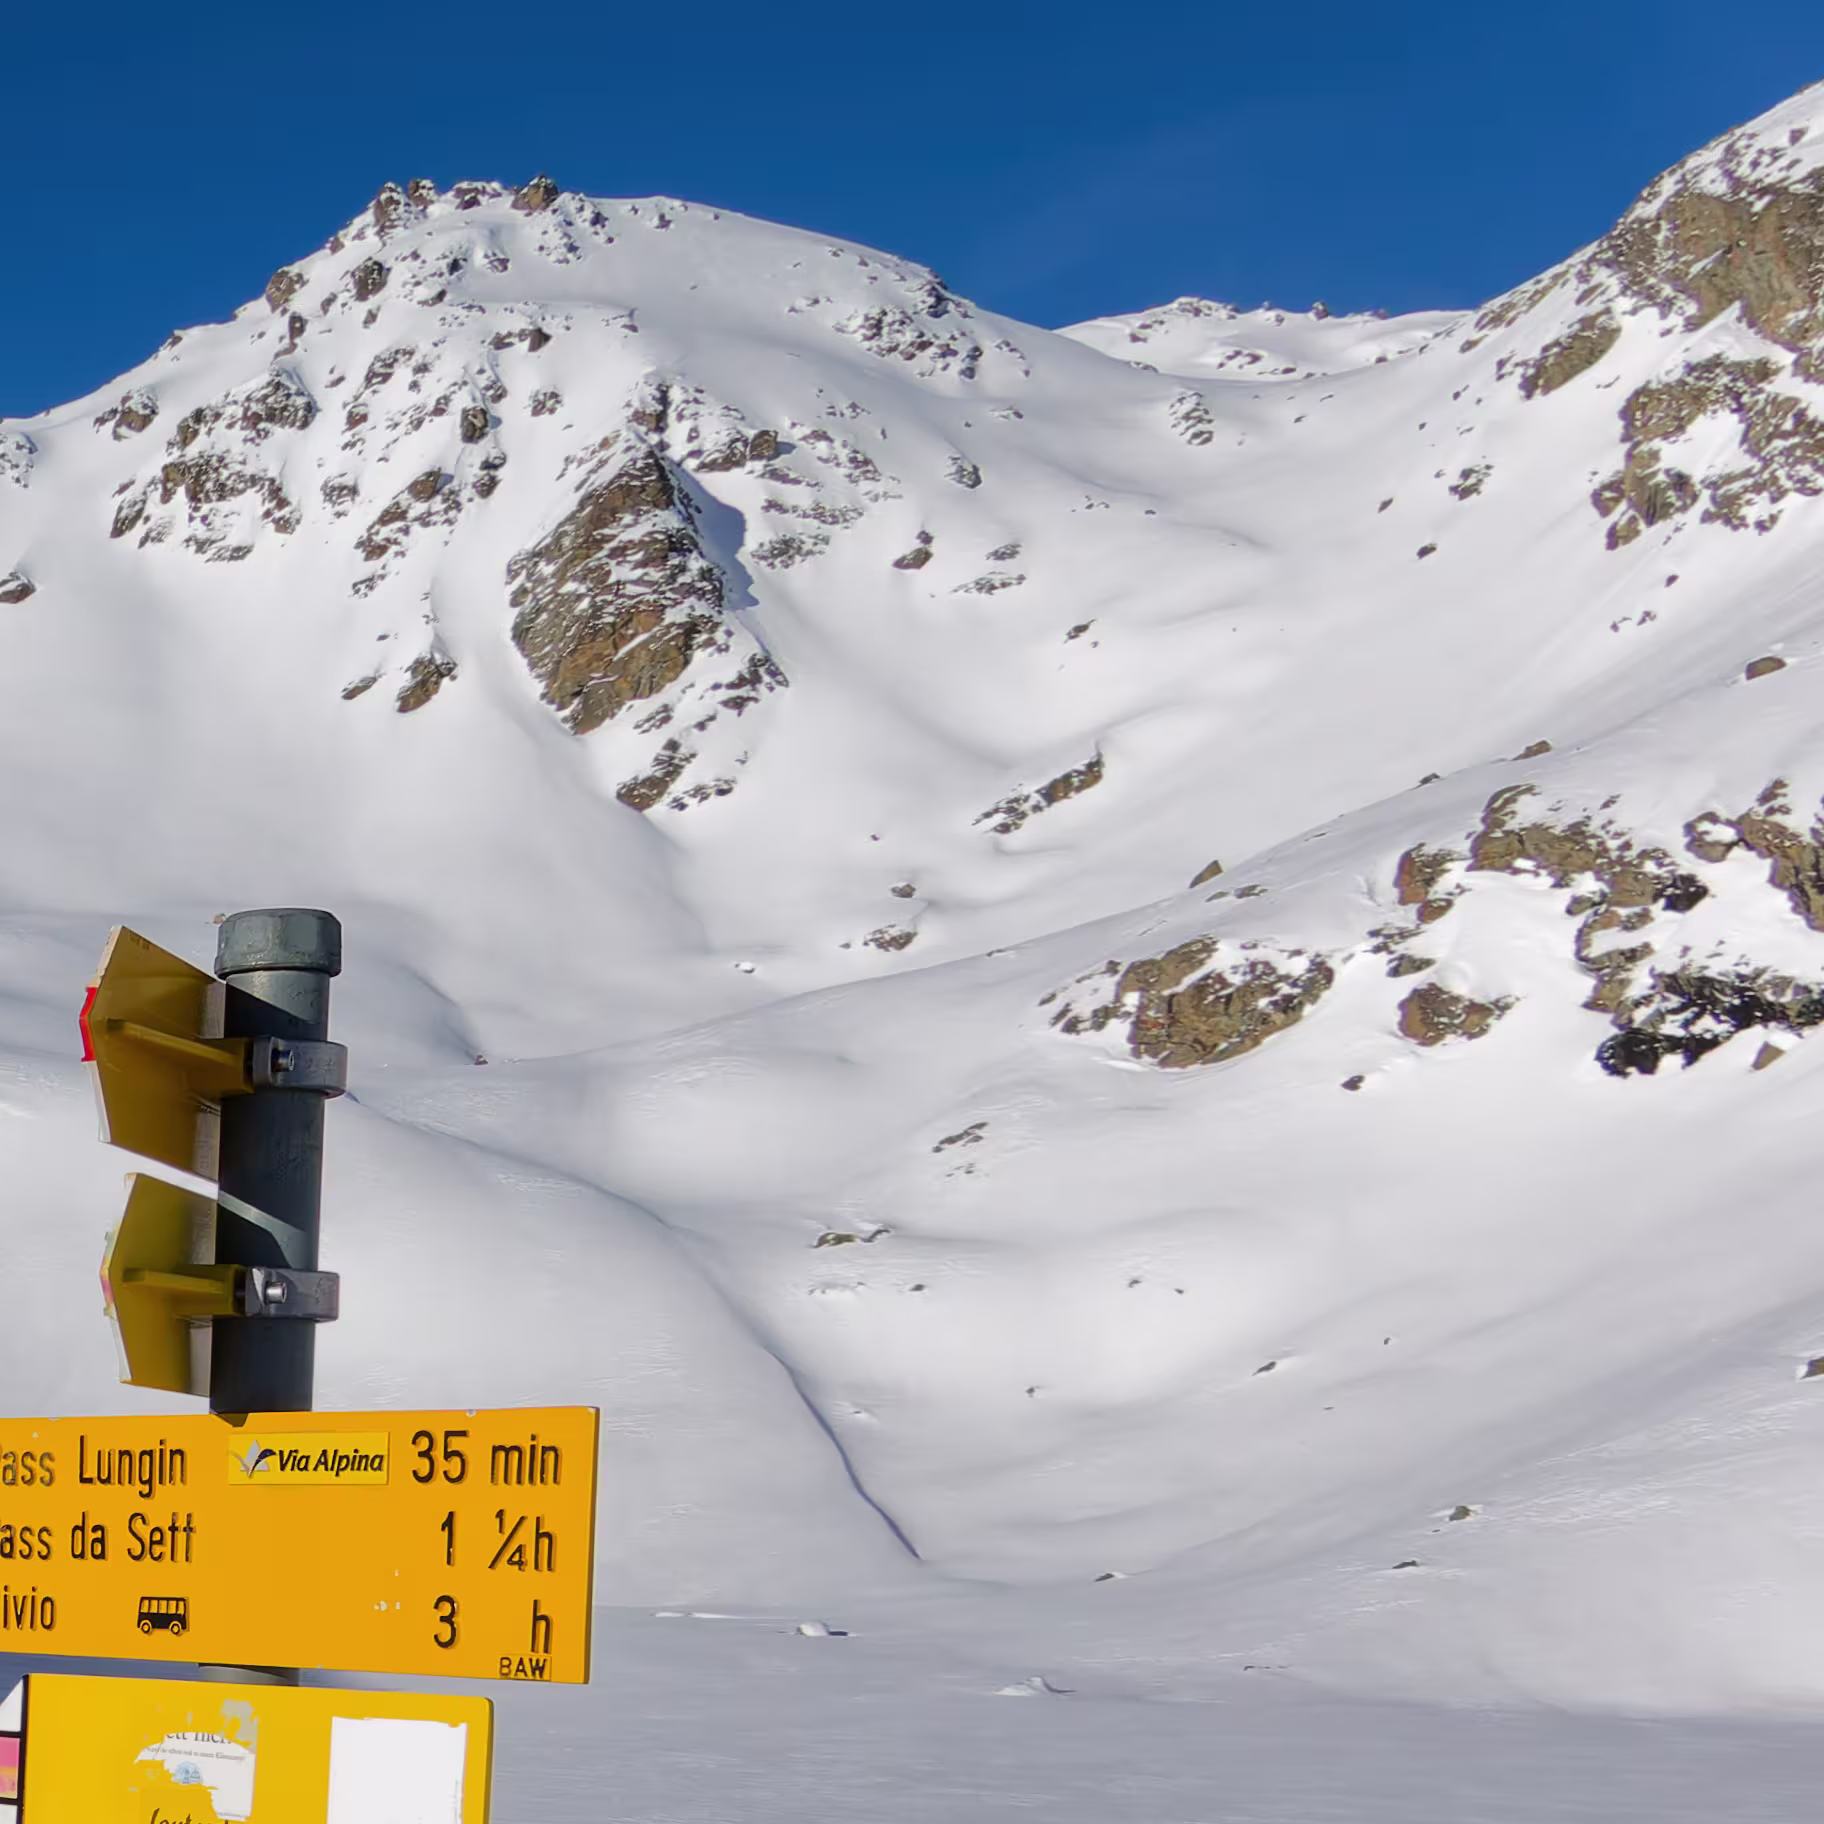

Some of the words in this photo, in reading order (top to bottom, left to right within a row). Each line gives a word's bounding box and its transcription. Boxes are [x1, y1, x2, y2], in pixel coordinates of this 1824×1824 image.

[78, 1435, 186, 1499] Lungin
[411, 1429, 469, 1484] 35
[490, 1433, 560, 1486] min
[277, 1448, 313, 1473] Via
[311, 1448, 384, 1477] Alpina
[70, 1511, 107, 1561] da
[126, 1511, 196, 1563] Sett
[439, 1510, 455, 1566] 1
[433, 1594, 458, 1649] 3
[530, 1599, 552, 1655] h
[499, 1656, 548, 1679] BAW
